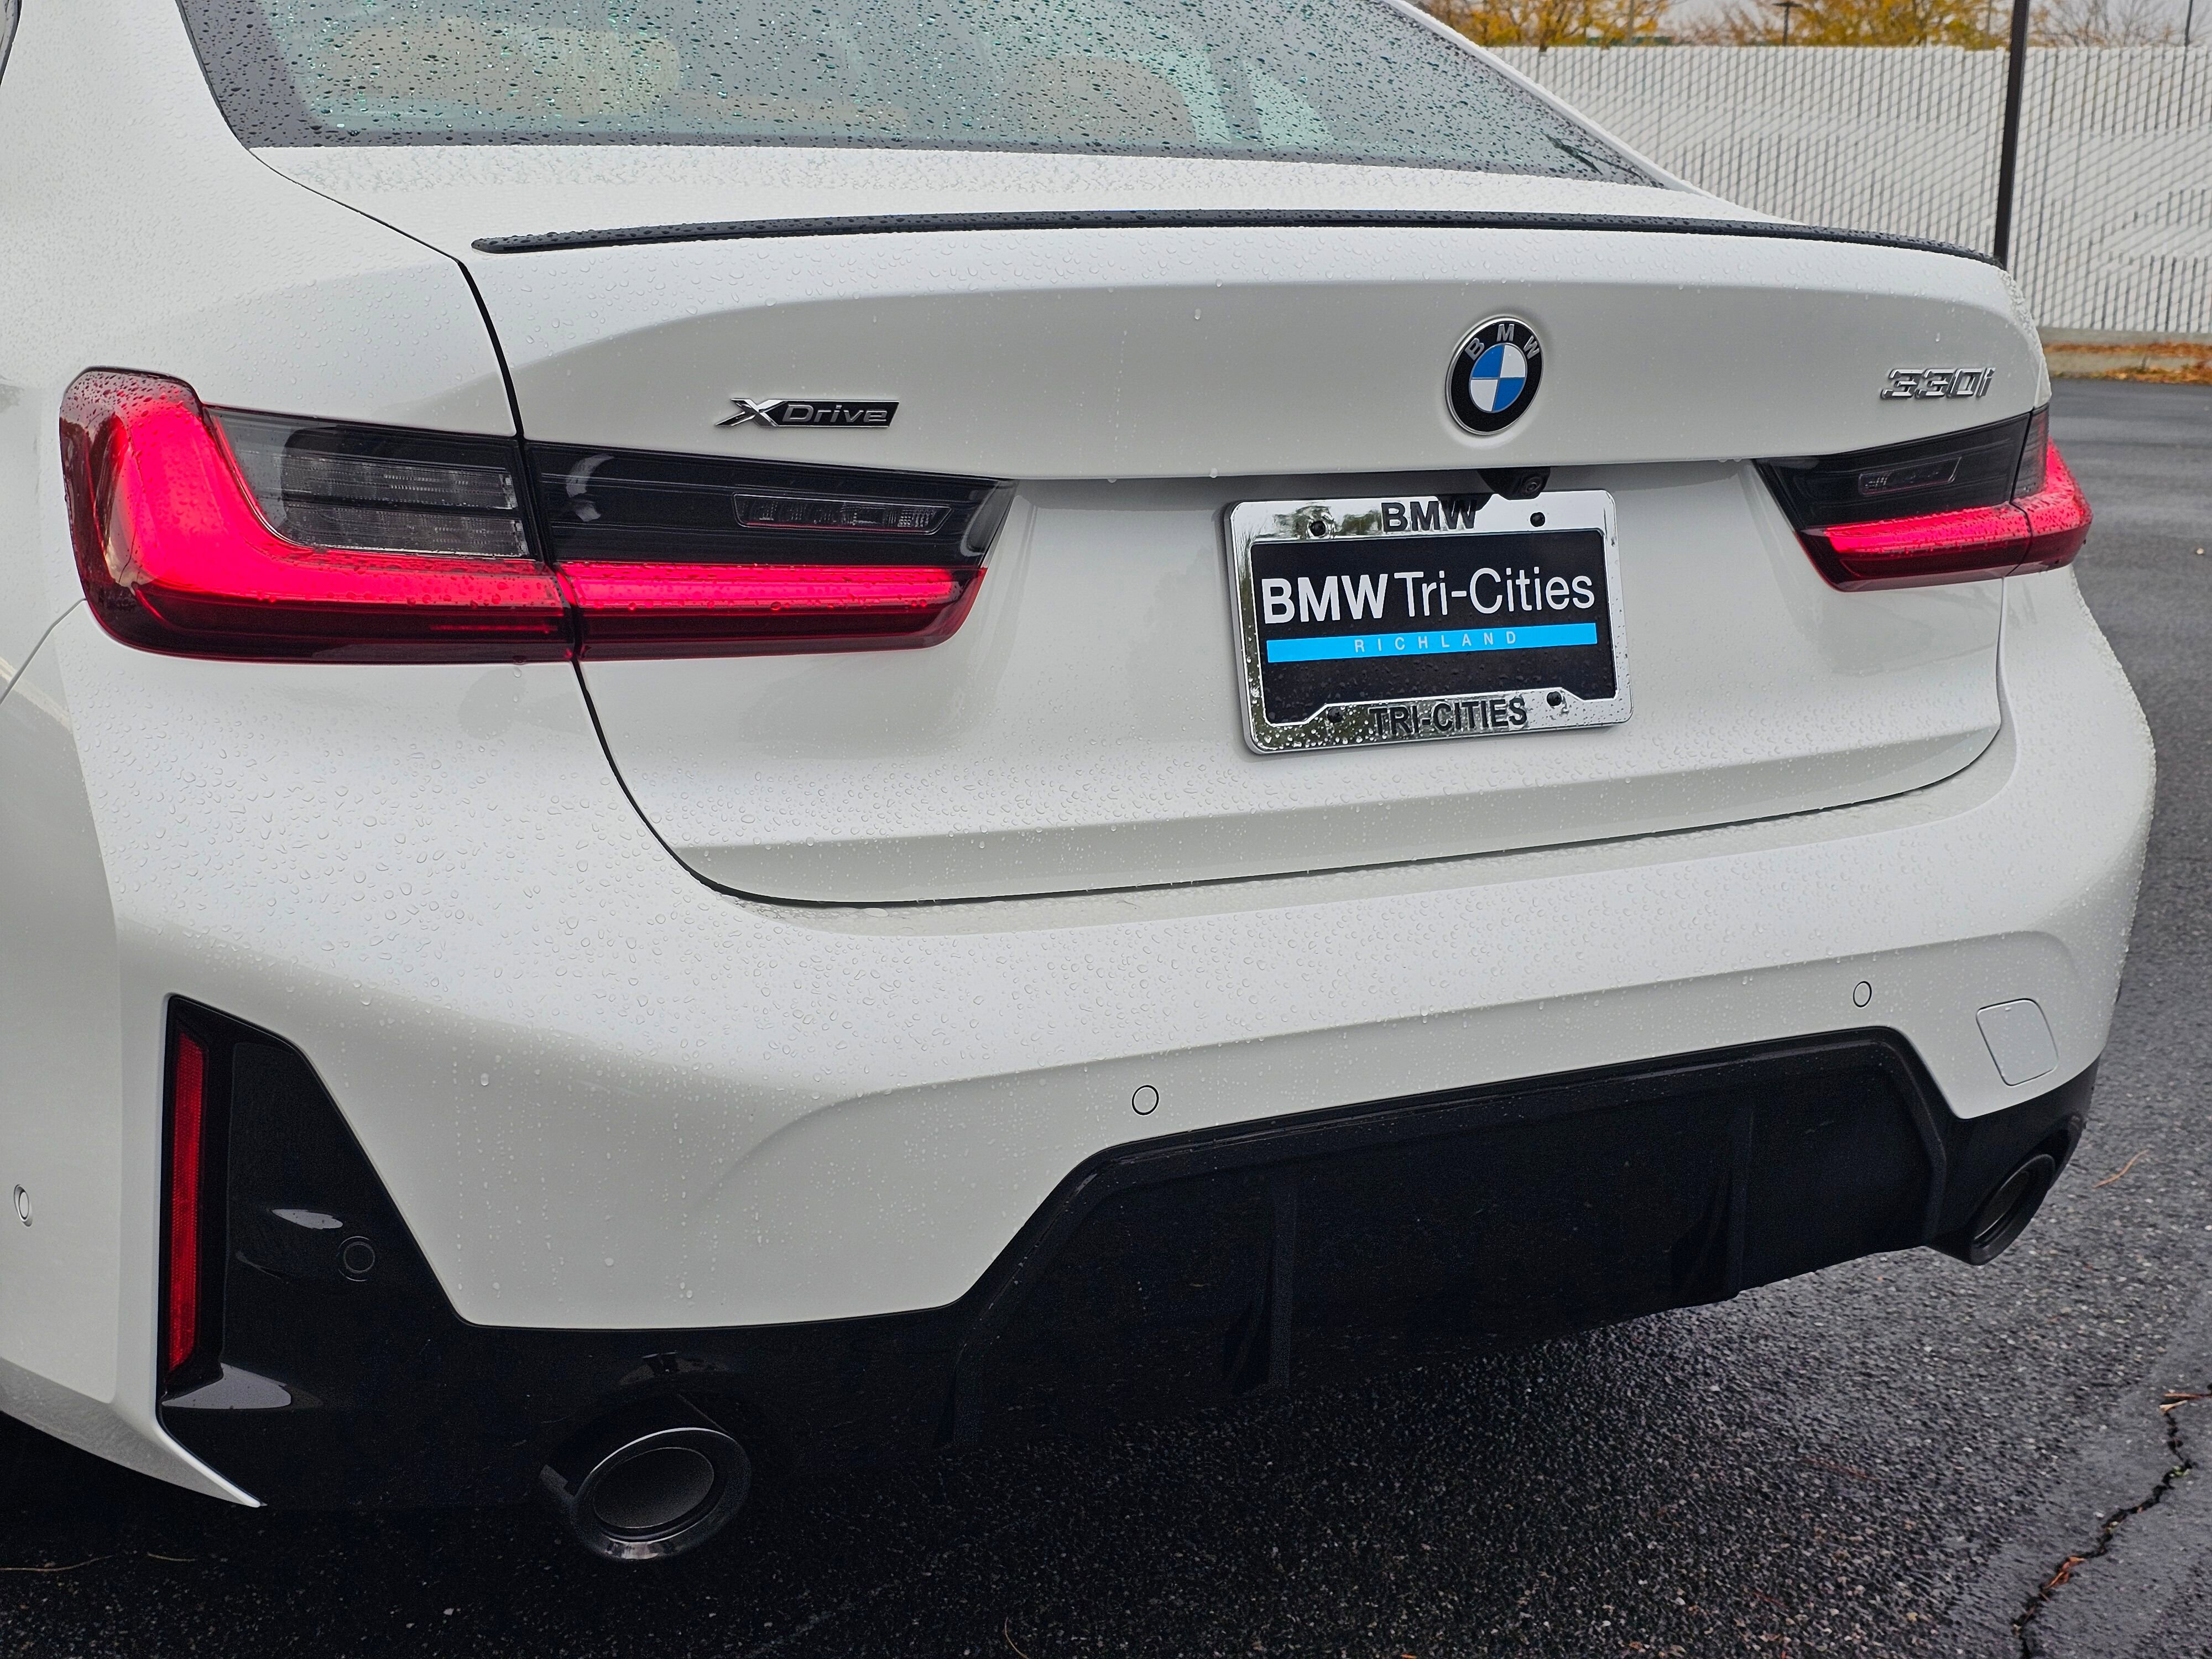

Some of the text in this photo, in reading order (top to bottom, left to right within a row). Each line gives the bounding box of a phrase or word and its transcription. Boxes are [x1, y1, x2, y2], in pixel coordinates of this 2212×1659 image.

[1464, 324, 1540, 361] BMW
[1881, 367, 1995, 399] 330i
[1381, 499, 1478, 532] BMW
[1261, 567, 1595, 624] BMW Tri-Cities
[1354, 630, 1517, 653] RICHLAND
[1368, 697, 1528, 735] TRI-CITIES
